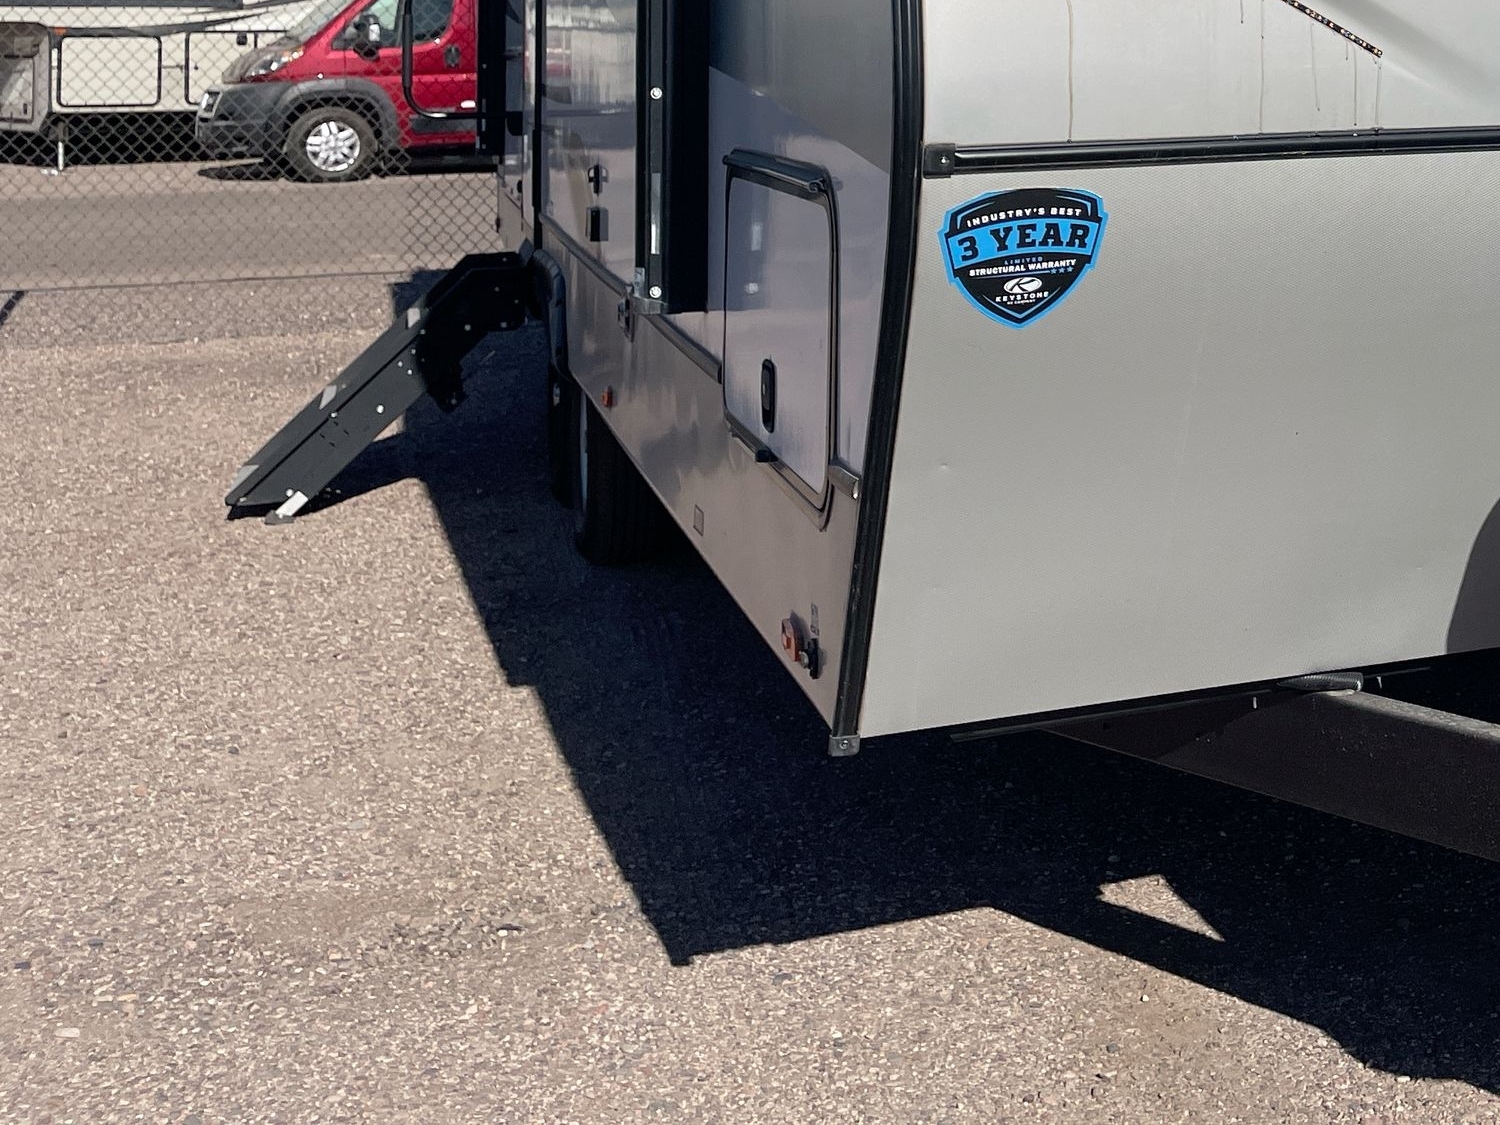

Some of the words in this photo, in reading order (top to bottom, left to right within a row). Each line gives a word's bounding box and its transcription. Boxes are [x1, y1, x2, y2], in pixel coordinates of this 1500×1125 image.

[966, 207, 1046, 228] INDUSTRY'S
[1050, 207, 1083, 217] BEST
[957, 235, 979, 262] 3
[989, 222, 1091, 253] YEAR
[969, 264, 1026, 277] STRUCTURAL
[1027, 258, 1077, 271] WARRANTY
[1004, 256, 1043, 265] LIMITED
[995, 291, 1049, 303] KEYSTONE
